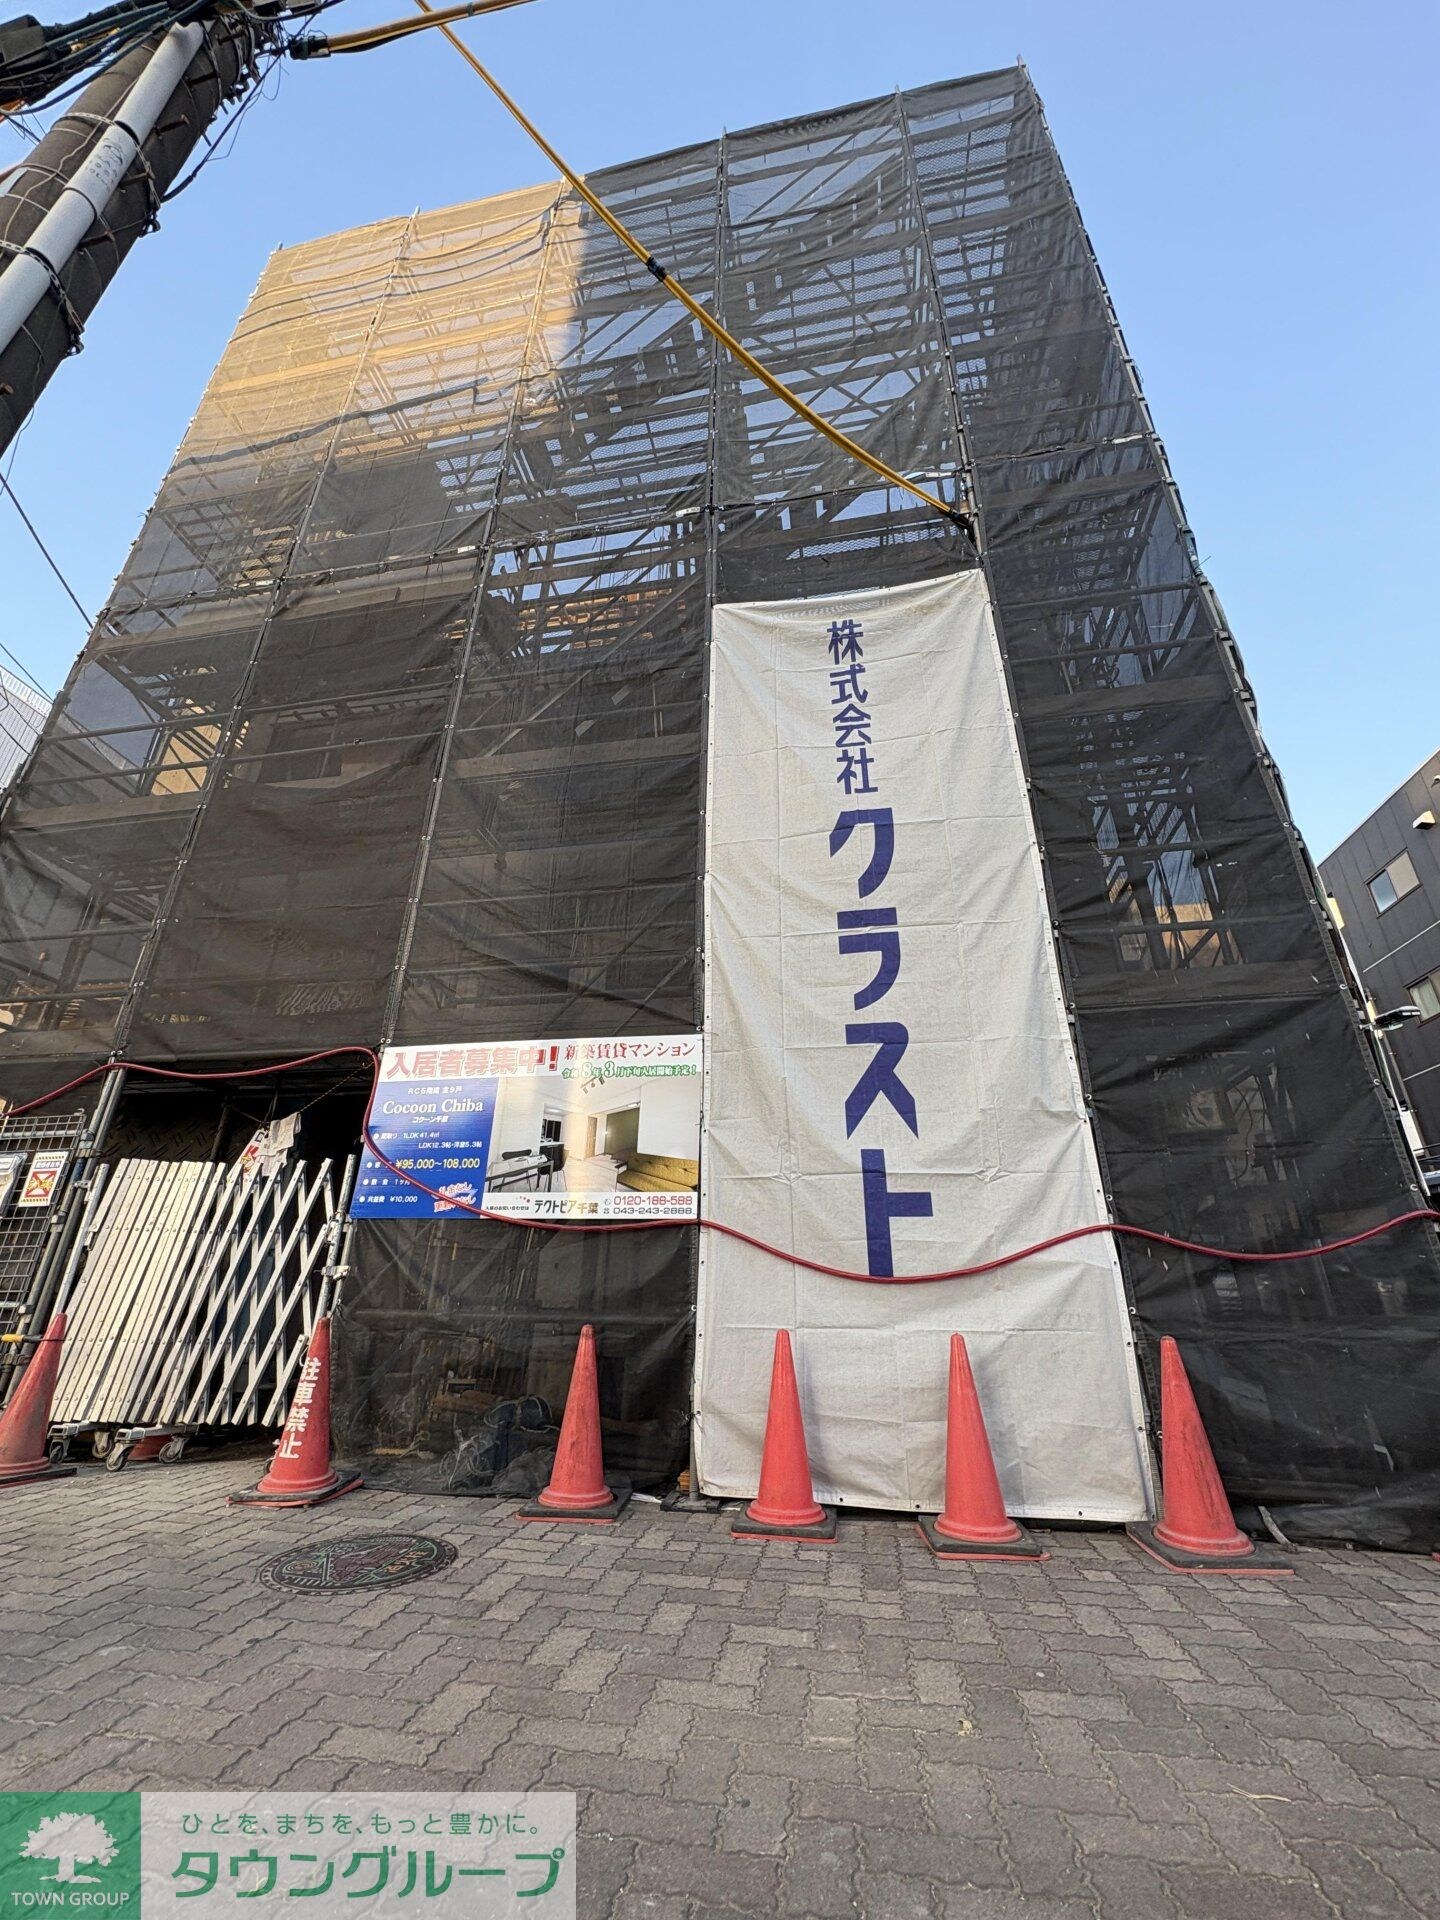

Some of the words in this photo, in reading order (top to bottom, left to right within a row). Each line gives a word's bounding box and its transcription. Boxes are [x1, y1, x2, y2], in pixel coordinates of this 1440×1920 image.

[826, 618, 879, 795] 株式会社
[564, 1042, 695, 1060] 新築賃貸マンション
[828, 807, 934, 1278] クラスト
[383, 1099, 437, 1114] Cocoon
[441, 1098, 484, 1113] Chiba
[534, 1198, 599, 1215] テクトピア千葉
[613, 1196, 693, 1206] 0120-188-588
[278, 1356, 321, 1459] 駐車禁止
